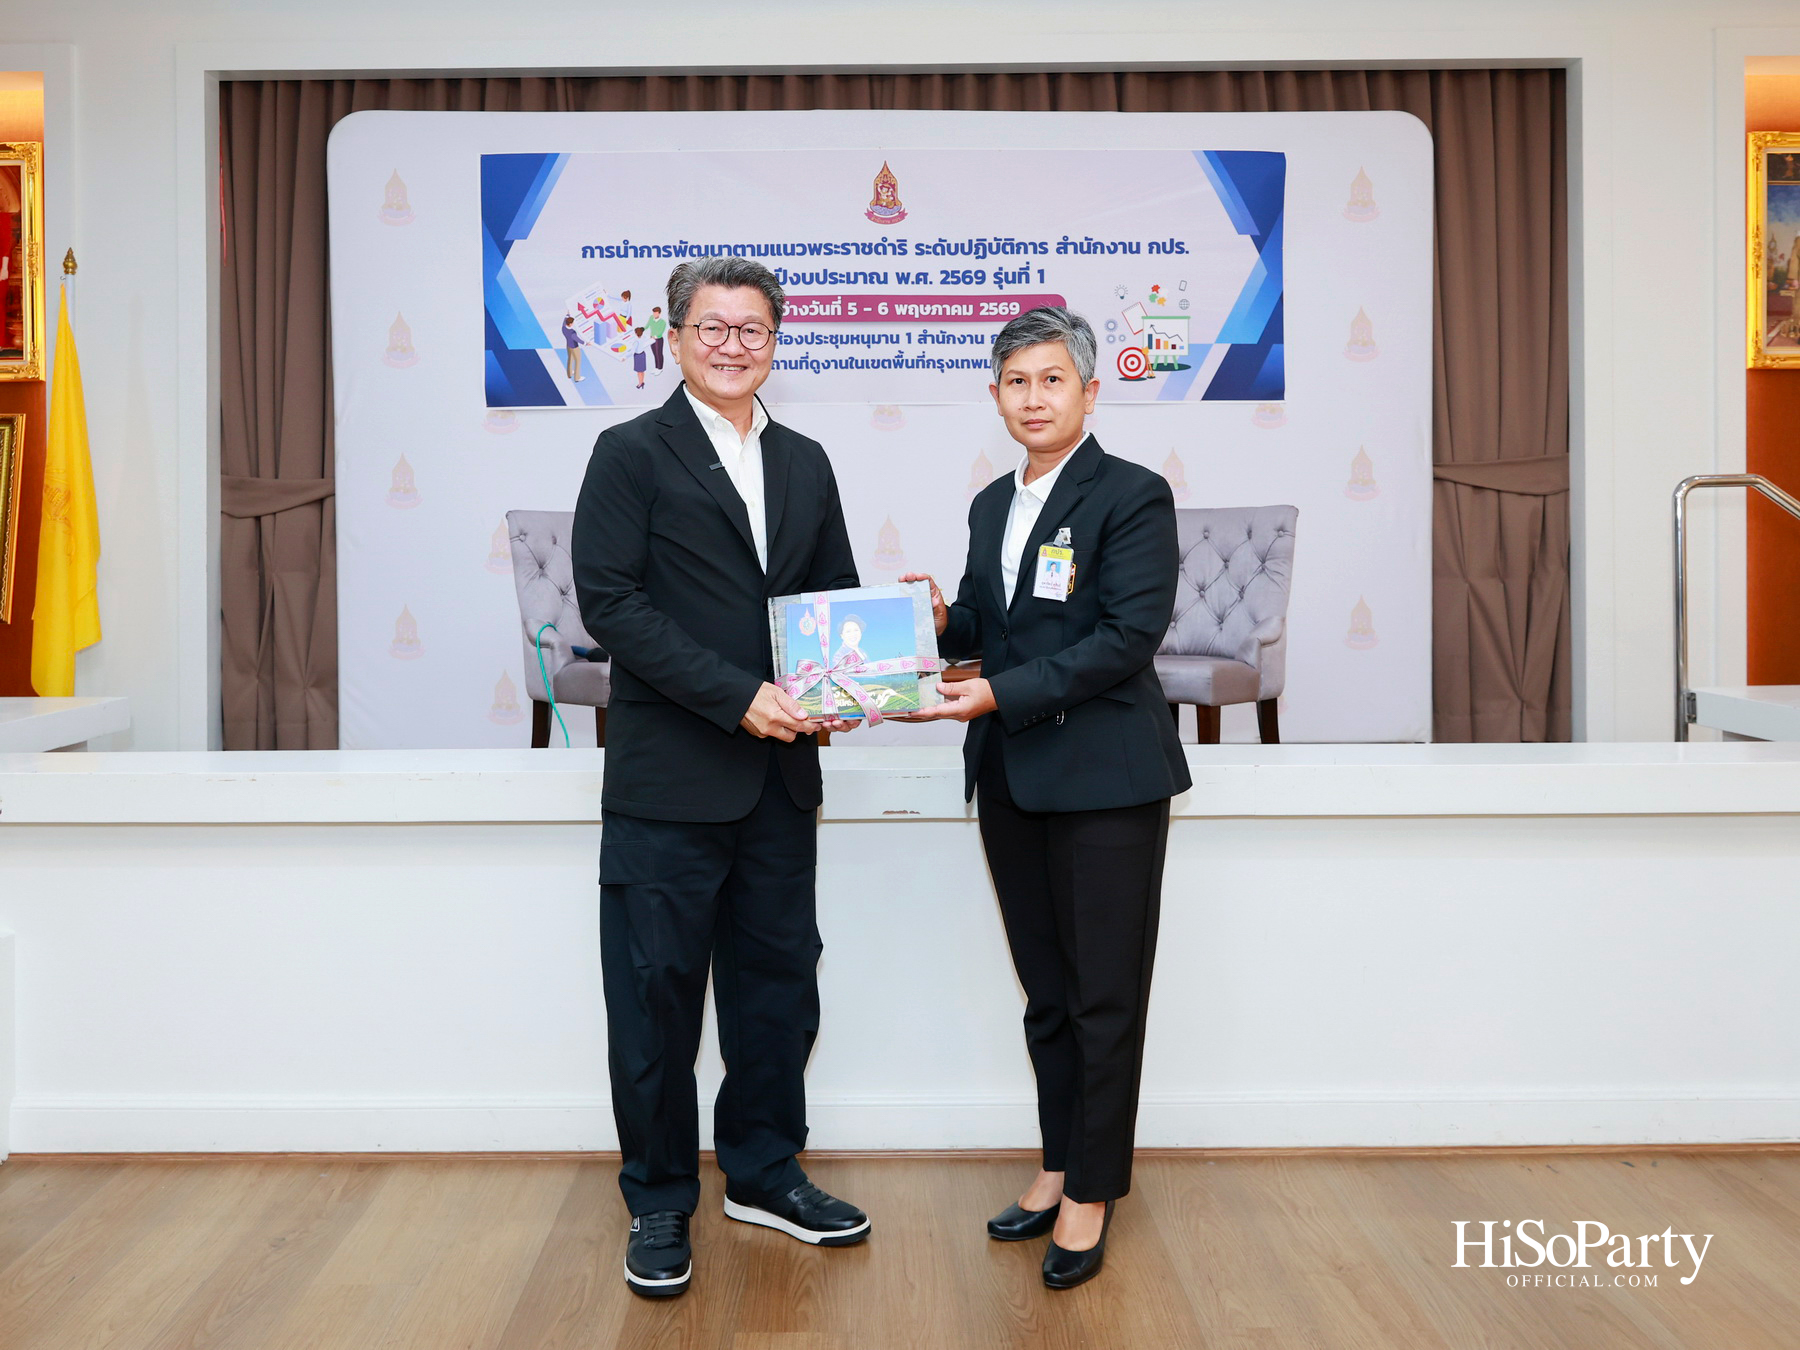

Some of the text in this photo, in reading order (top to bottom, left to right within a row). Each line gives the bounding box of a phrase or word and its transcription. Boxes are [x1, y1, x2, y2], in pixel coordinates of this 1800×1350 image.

[581, 236, 1190, 260] การนำการพัฒนาตามแนวพระราชดำริ ระดับปฏิบัติการ สำนักงาน กปร.
[774, 261, 1045, 290] ปีงบประมาณ พ.ศ. 2569 รุ่นที่ 1
[847, 302, 858, 316] 5
[877, 302, 889, 316] 6
[894, 303, 974, 318] พฤษภาคม
[979, 301, 1021, 316] 2569
[905, 332, 912, 345] 1
[917, 329, 985, 345] สำนักงาน
